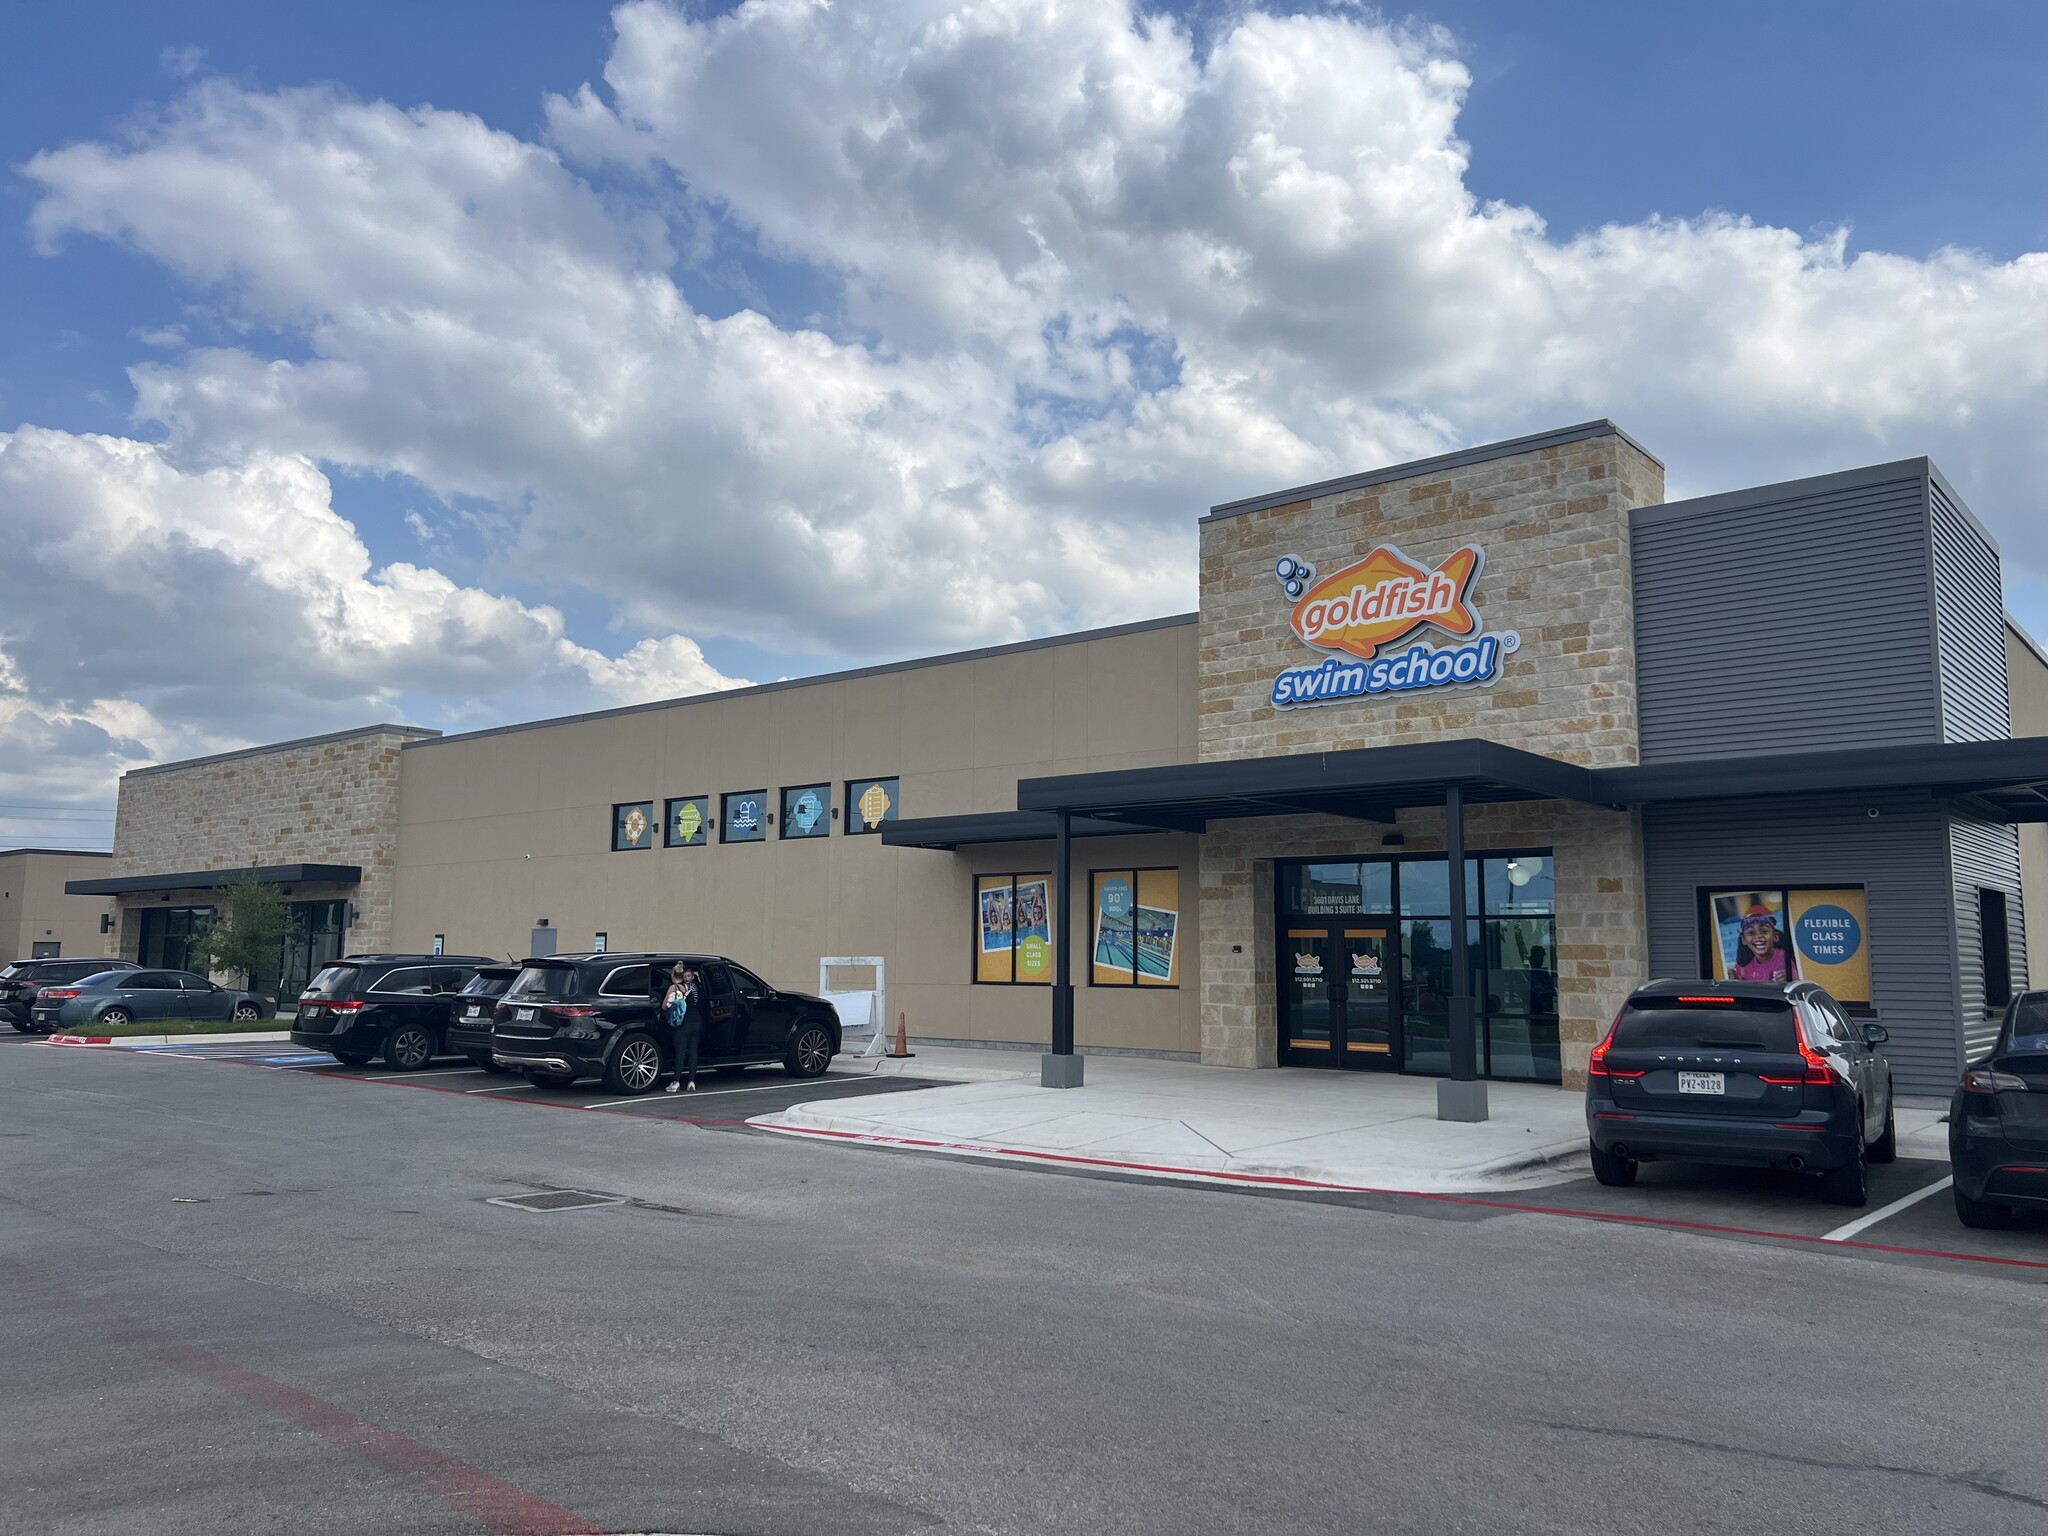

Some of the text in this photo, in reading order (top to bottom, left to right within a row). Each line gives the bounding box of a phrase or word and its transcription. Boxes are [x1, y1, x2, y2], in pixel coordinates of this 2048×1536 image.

[1304, 574, 1450, 637] goldfish
[1274, 664, 1364, 700] swim
[1369, 640, 1495, 688] school
[1328, 895, 1344, 904] DAVIS
[1345, 895, 1360, 904] LANE
[1307, 906, 1334, 915] BUILDING
[1339, 905, 1356, 914] SUITE
[1804, 919, 1851, 928] FLEXIBLE
[1811, 932, 1844, 941] CLASS
[1812, 945, 1844, 954] TIMES
[1658, 1055, 1741, 1064] VOLVO
